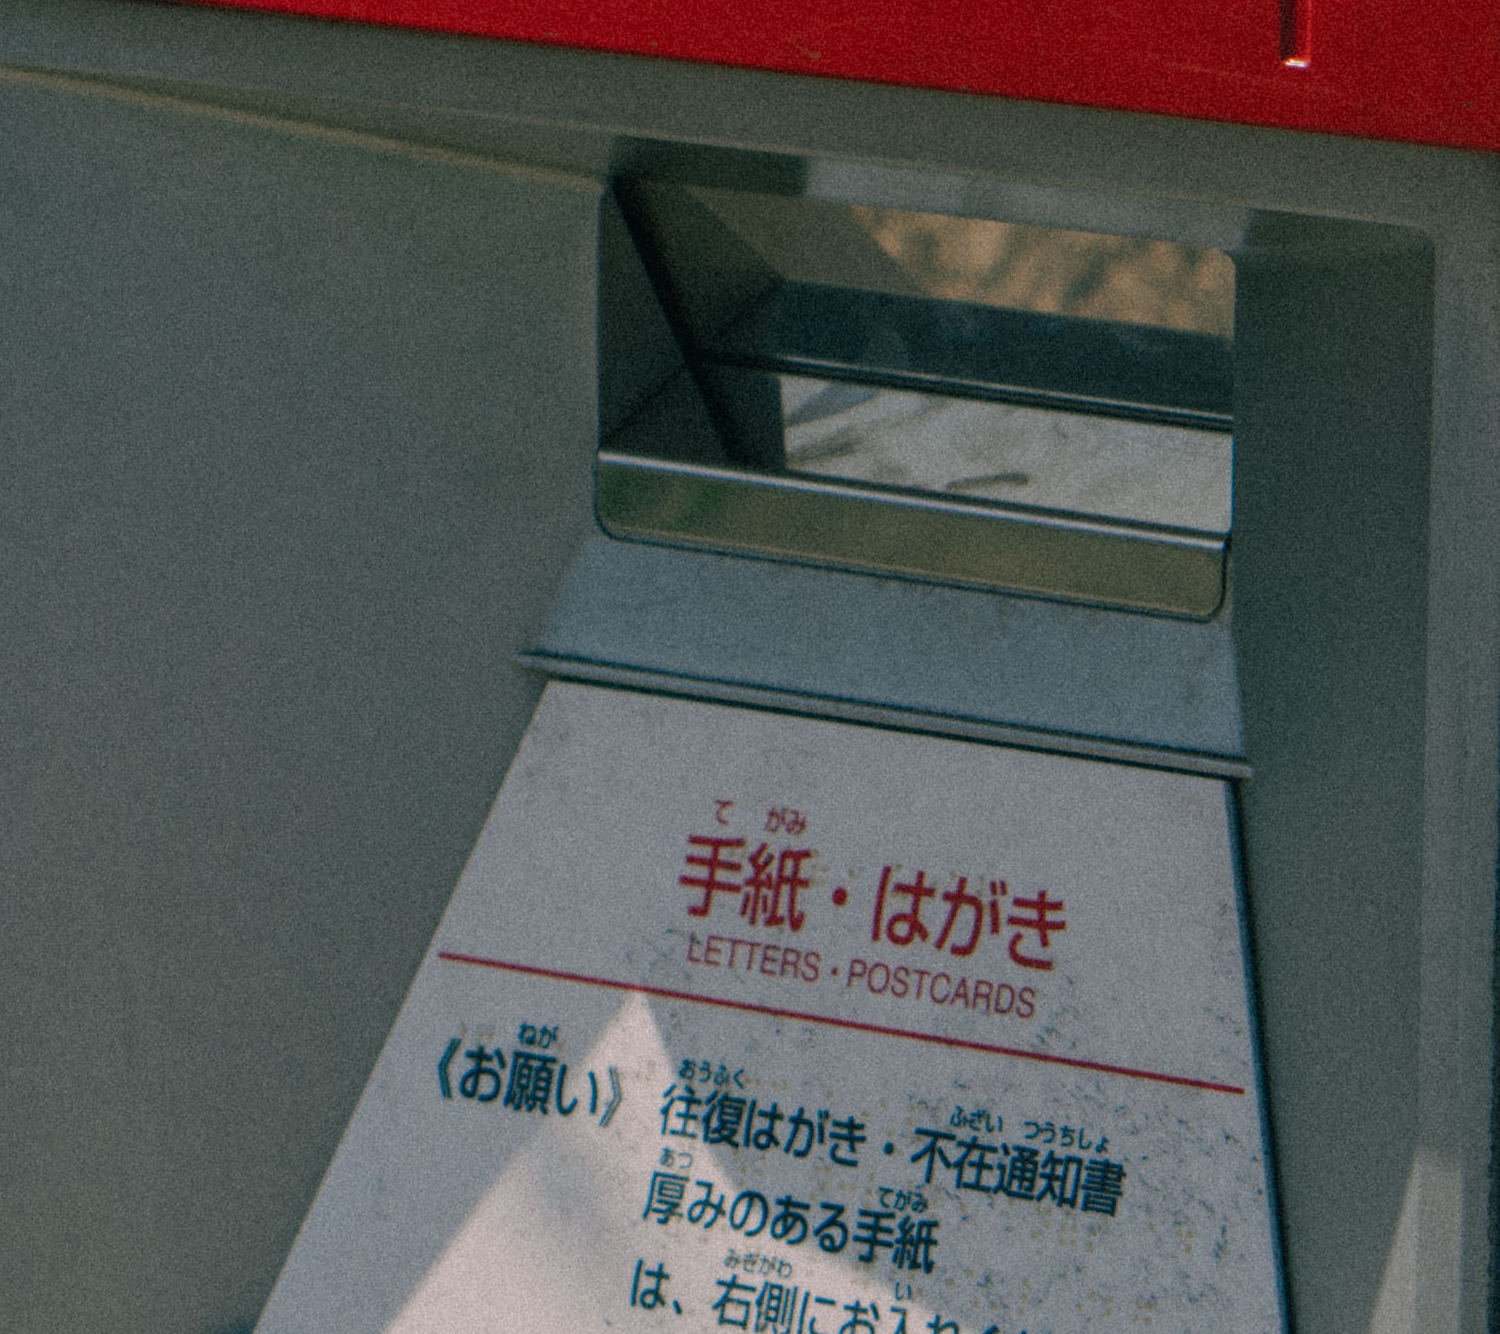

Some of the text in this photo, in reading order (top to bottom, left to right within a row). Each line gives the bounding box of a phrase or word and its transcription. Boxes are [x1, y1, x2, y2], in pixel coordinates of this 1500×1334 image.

[714, 798, 807, 835] て がみ
[679, 834, 1067, 971] 手紙・はがき
[517, 1021, 560, 1050] ねが
[678, 1058, 745, 1090] おうふく
[642, 1170, 939, 1275] 厚みのある手紙
